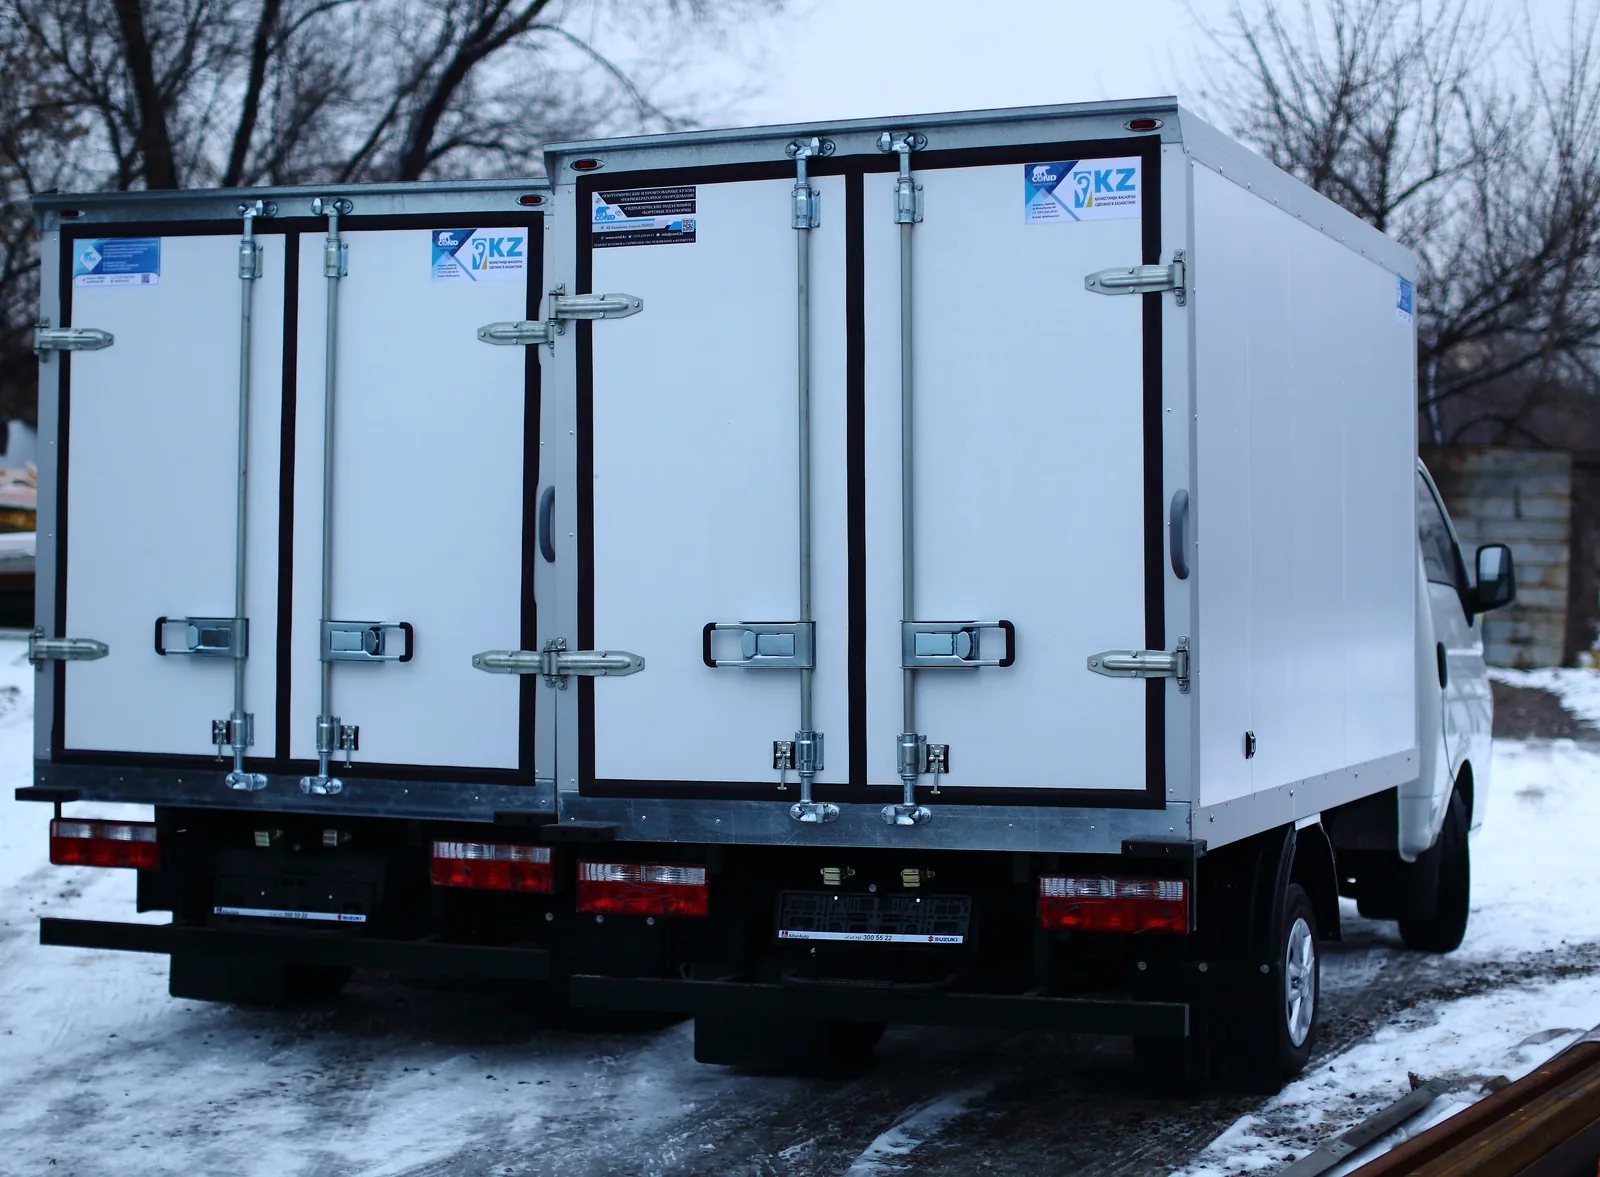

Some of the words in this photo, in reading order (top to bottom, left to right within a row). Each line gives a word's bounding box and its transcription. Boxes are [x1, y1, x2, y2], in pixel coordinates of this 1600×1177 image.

[1032, 174, 1057, 182] COND
[1095, 168, 1136, 193] KZ
[489, 237, 523, 257] KZ
